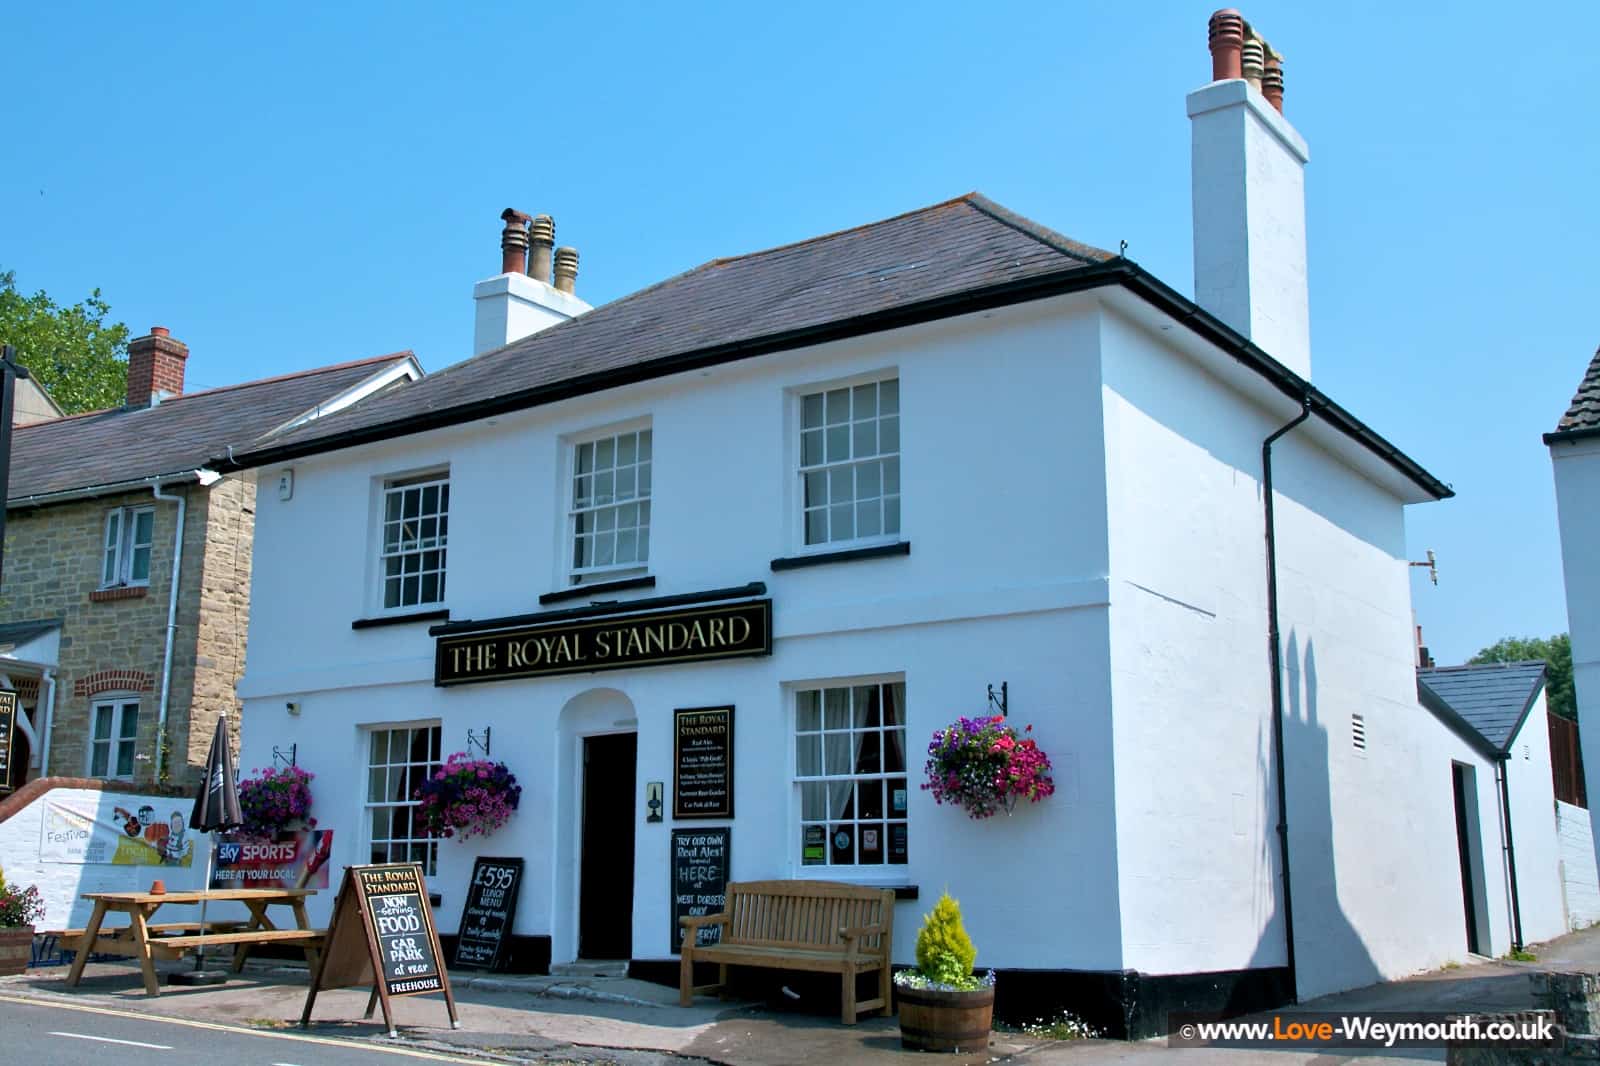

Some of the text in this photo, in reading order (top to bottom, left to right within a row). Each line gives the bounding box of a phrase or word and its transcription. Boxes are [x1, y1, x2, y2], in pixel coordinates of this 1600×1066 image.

[450, 616, 751, 673] THE ROYAL STANDARD
[680, 715, 727, 726] THE ROYAL
[680, 725, 725, 736] STANDARD
[48, 829, 89, 843] Festival
[677, 836, 723, 846] TRY OUR OWN
[220, 844, 295, 863] sky SPORTS
[677, 847, 697, 857] Real
[215, 869, 296, 880] HERE AT YOUR LOCAL
[361, 870, 417, 883] THE ROYAL
[679, 865, 719, 881] HERE
[366, 882, 417, 894] STANDARD
[482, 888, 505, 898] LUNCH
[383, 896, 408, 908] NOW
[480, 897, 502, 907] MENU
[378, 915, 420, 934] FOOD
[391, 938, 416, 950] CAR
[390, 948, 424, 962] PARK
[395, 963, 428, 976] at rear
[391, 979, 439, 993] FREEHOUSE
